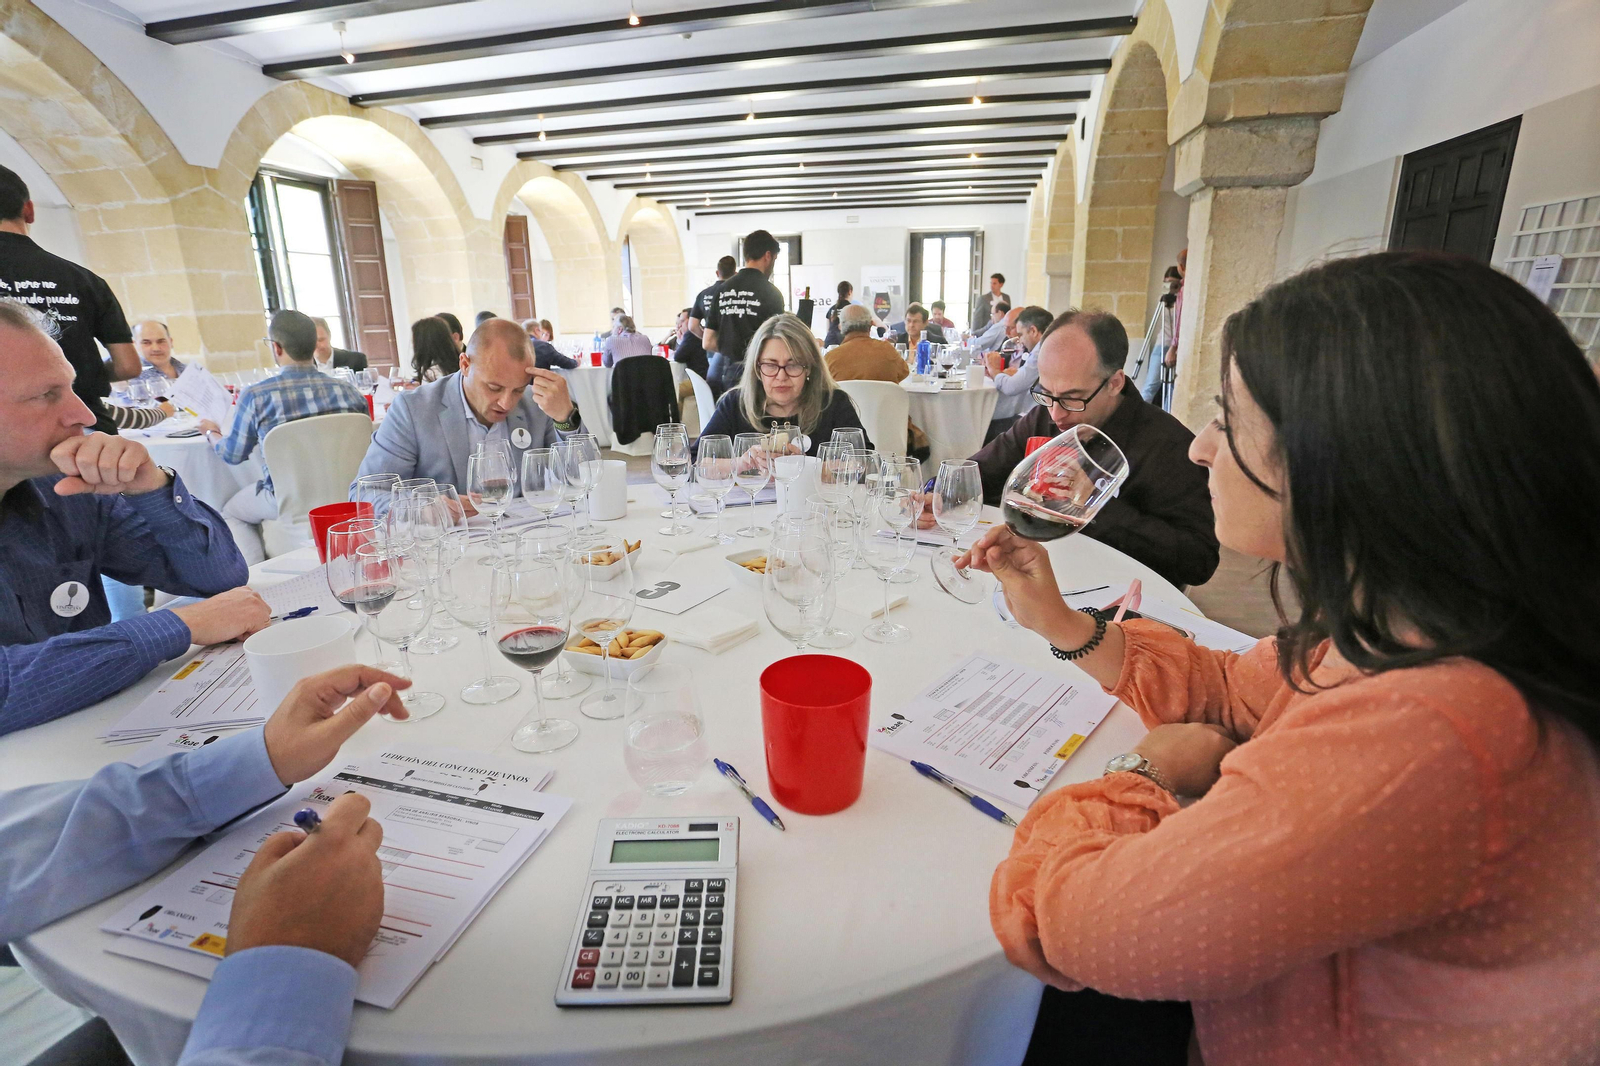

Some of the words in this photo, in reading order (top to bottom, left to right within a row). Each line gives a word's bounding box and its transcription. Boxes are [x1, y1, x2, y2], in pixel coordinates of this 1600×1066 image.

[14, 280, 41, 292] pero
[13, 293, 45, 304] undo
[45, 293, 80, 307] puede
[812, 296, 832, 306] eae
[421, 760, 439, 768] DEL
[439, 762, 487, 775] CONCURSO
[487, 770, 500, 778] DE
[501, 772, 531, 783] VINOS
[314, 792, 335, 802] feae
[640, 913, 647, 921] 8
[685, 912, 694, 920] %
[613, 932, 620, 940] 4
[637, 932, 643, 940] 5
[581, 952, 593, 960] CE
[610, 952, 614, 960] 1
[633, 951, 640, 959] 2
[658, 951, 664, 959] 3
[604, 972, 611, 980] 0
[626, 971, 640, 980] 00
